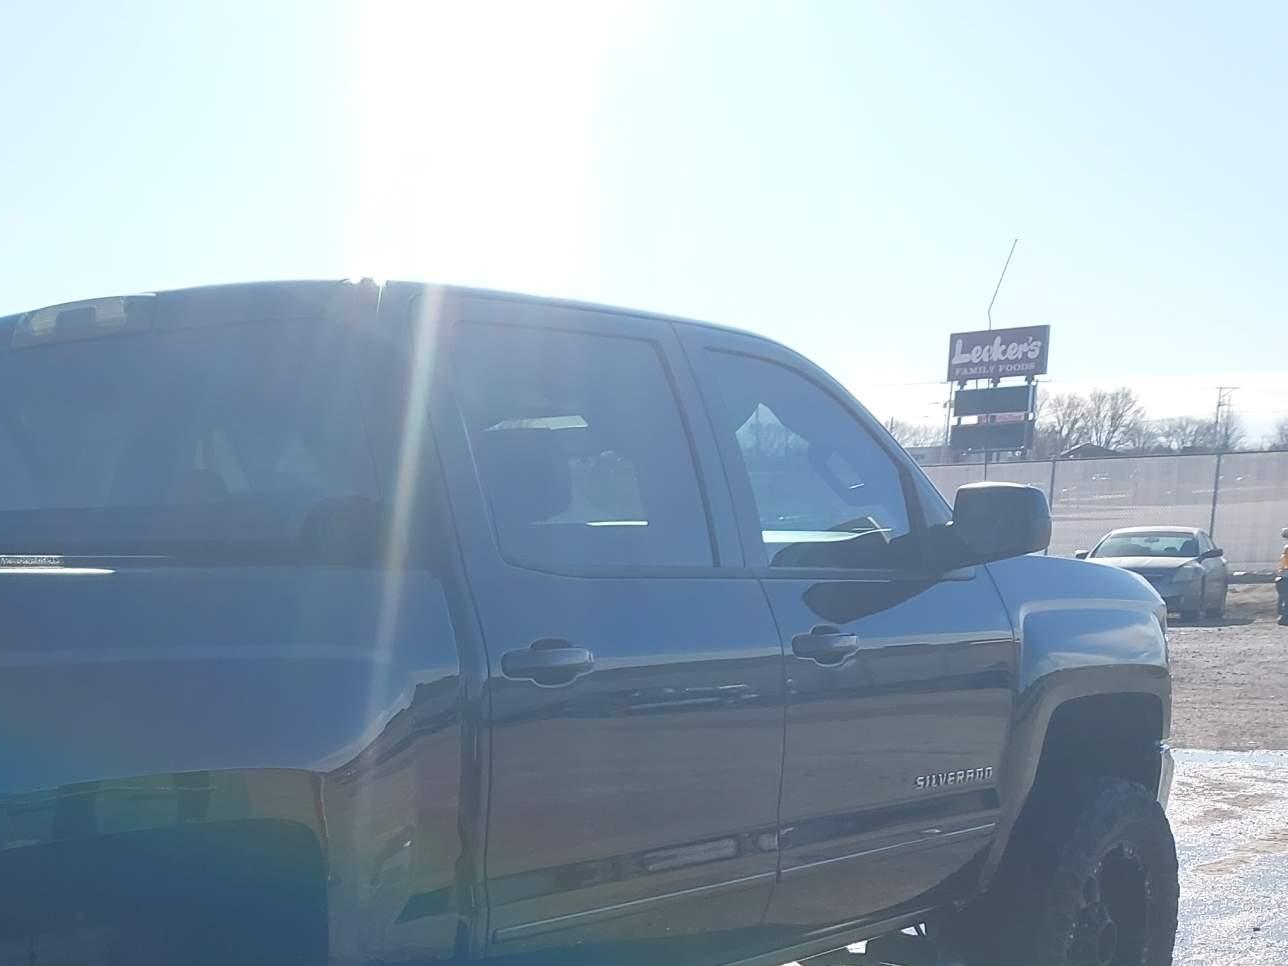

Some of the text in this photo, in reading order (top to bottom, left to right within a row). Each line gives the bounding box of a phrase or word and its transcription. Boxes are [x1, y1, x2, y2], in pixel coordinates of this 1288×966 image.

[954, 362, 1036, 376] FAMILY FOODS
[915, 766, 993, 790] SILVERADO
